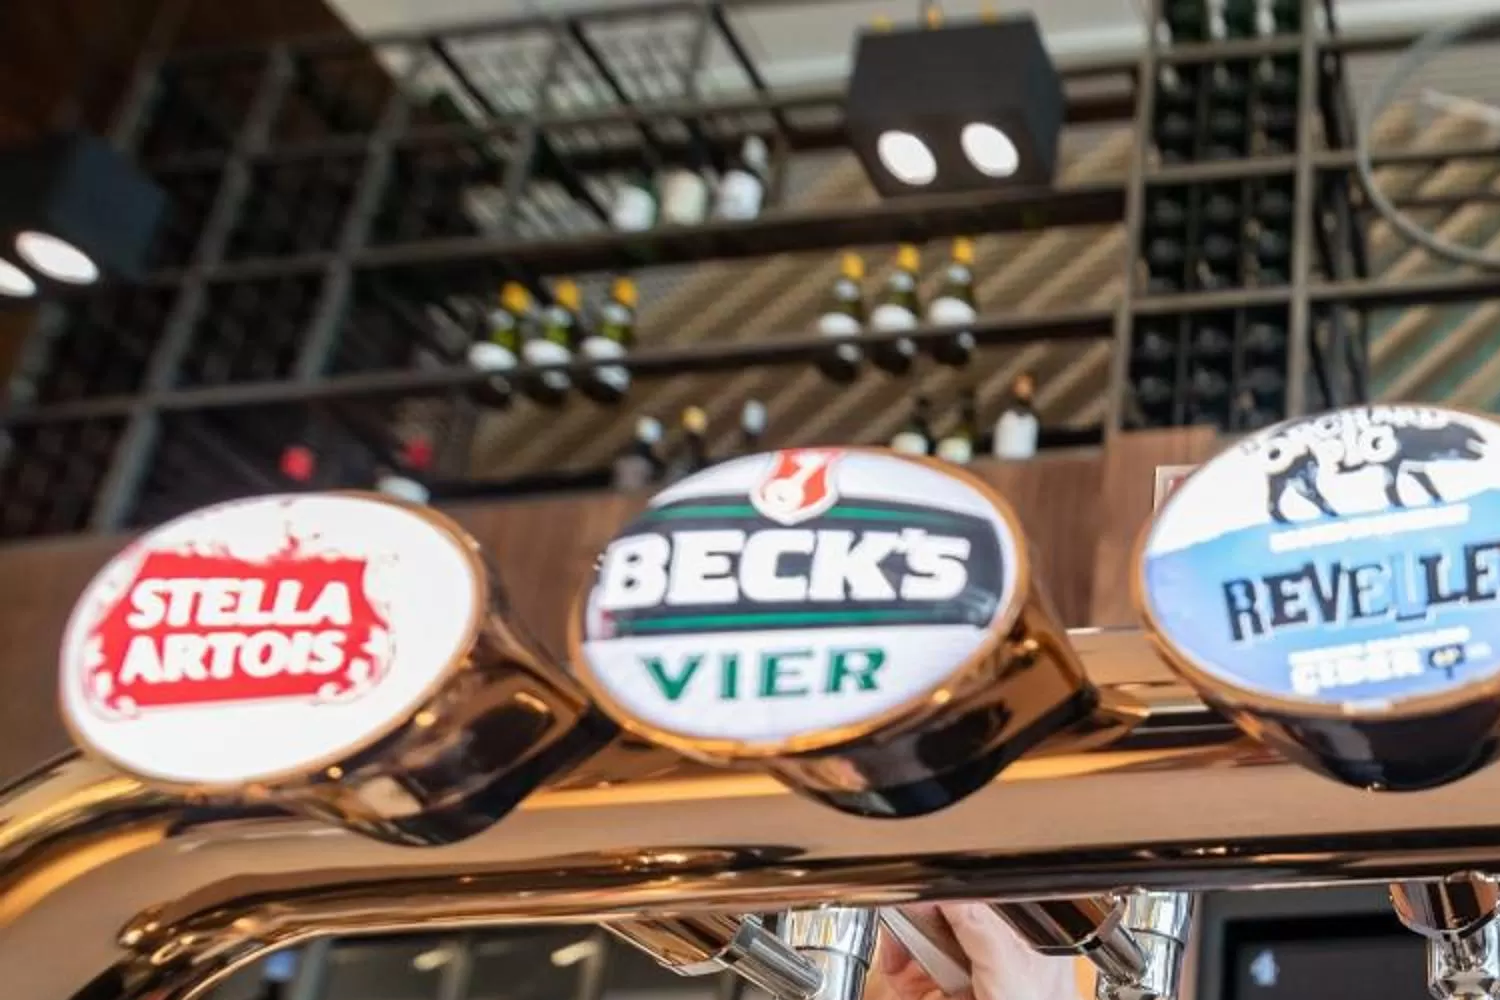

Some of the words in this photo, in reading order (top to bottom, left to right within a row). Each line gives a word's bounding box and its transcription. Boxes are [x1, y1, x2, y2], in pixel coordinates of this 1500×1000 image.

[596, 528, 971, 610] BECK'S
[126, 576, 353, 631] STELLA
[119, 630, 347, 685] ARTOIS
[638, 646, 889, 702] VIER
